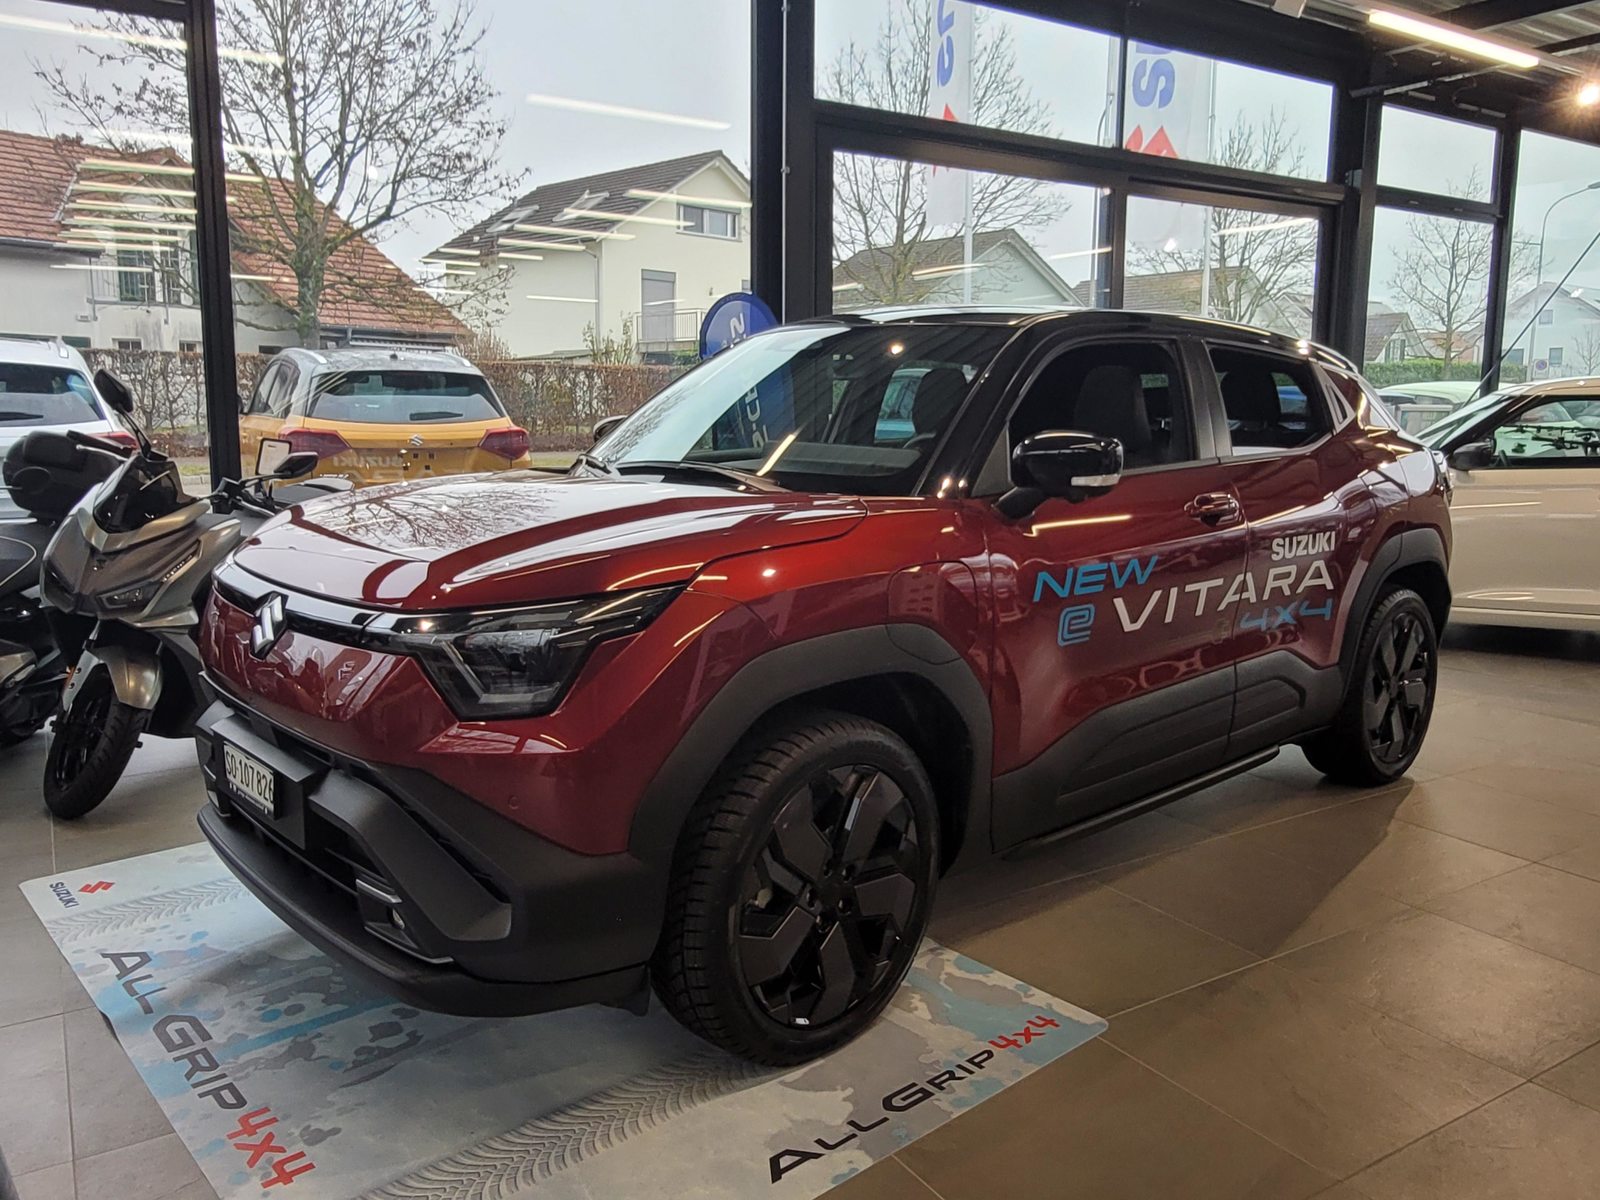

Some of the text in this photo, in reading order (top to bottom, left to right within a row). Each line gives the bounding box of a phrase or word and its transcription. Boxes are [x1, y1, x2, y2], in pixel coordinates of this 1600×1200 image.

[1271, 531, 1336, 561] SUZUKI
[1033, 556, 1158, 602] NEW
[1113, 560, 1334, 633] VITARA
[50, 882, 79, 908] SUZUKI
